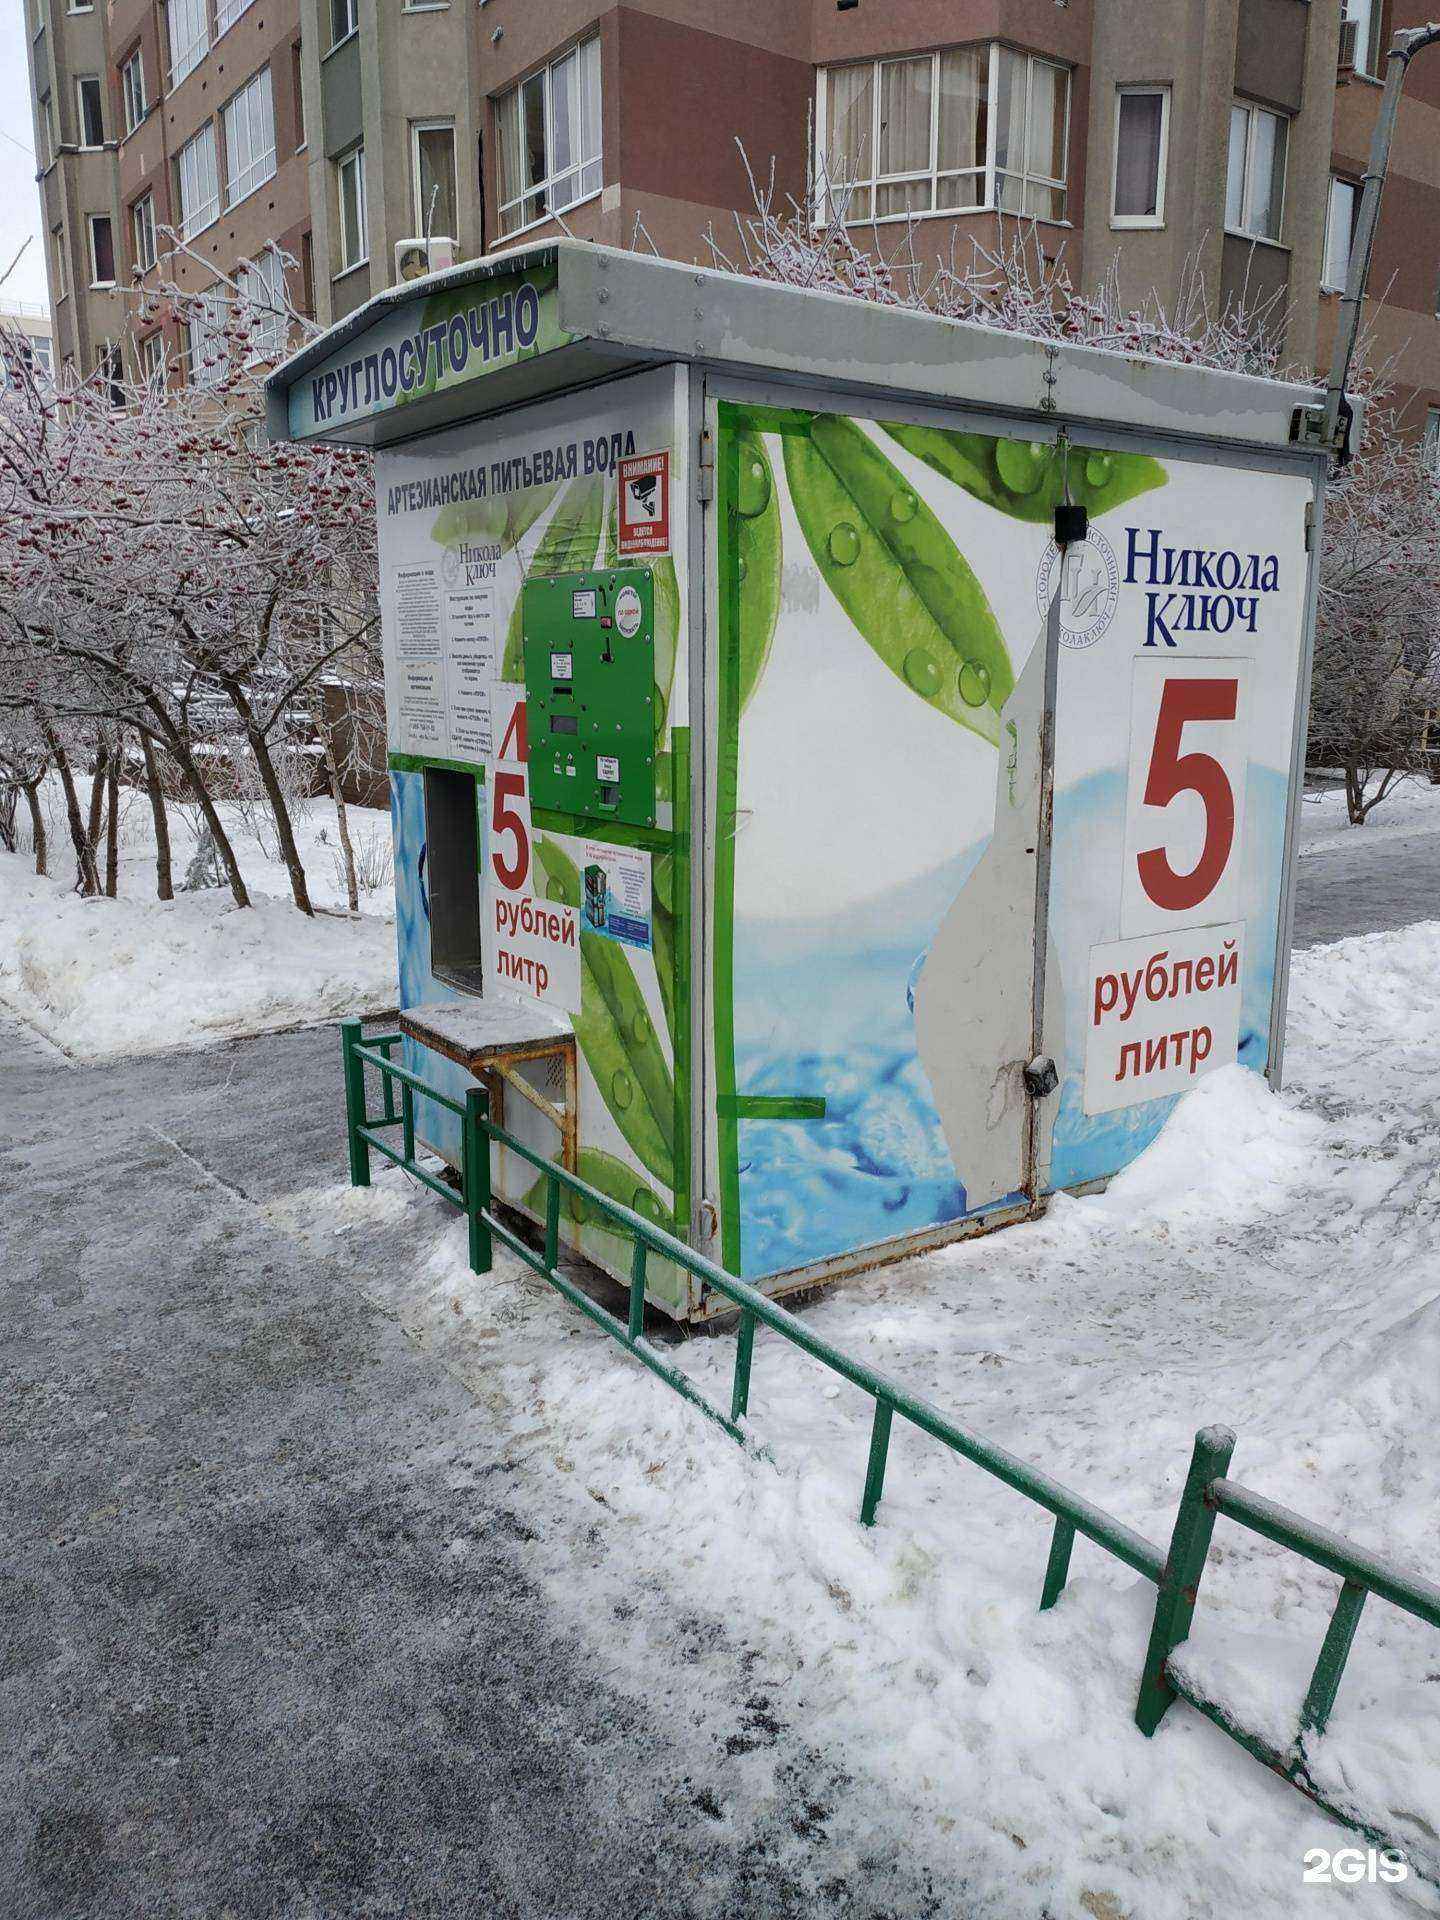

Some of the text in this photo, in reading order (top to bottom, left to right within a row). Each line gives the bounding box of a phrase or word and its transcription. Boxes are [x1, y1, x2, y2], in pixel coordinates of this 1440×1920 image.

[312, 282, 540, 422] КРУГЛОСУТОЧНО
[387, 430, 636, 516] АРТЕЗИАНСКАЯ ПИТЬЕВАЯ ВОДА
[466, 562, 497, 586] Ключ
[1122, 527, 1280, 592] Никола
[1143, 592, 1260, 647] Ключ
[1137, 678, 1239, 911] 5
[492, 771, 529, 891] 5
[495, 897, 576, 947] рублей
[497, 948, 549, 997] литр
[1093, 938, 1239, 1026] рублей
[1114, 1024, 1213, 1082] литр
